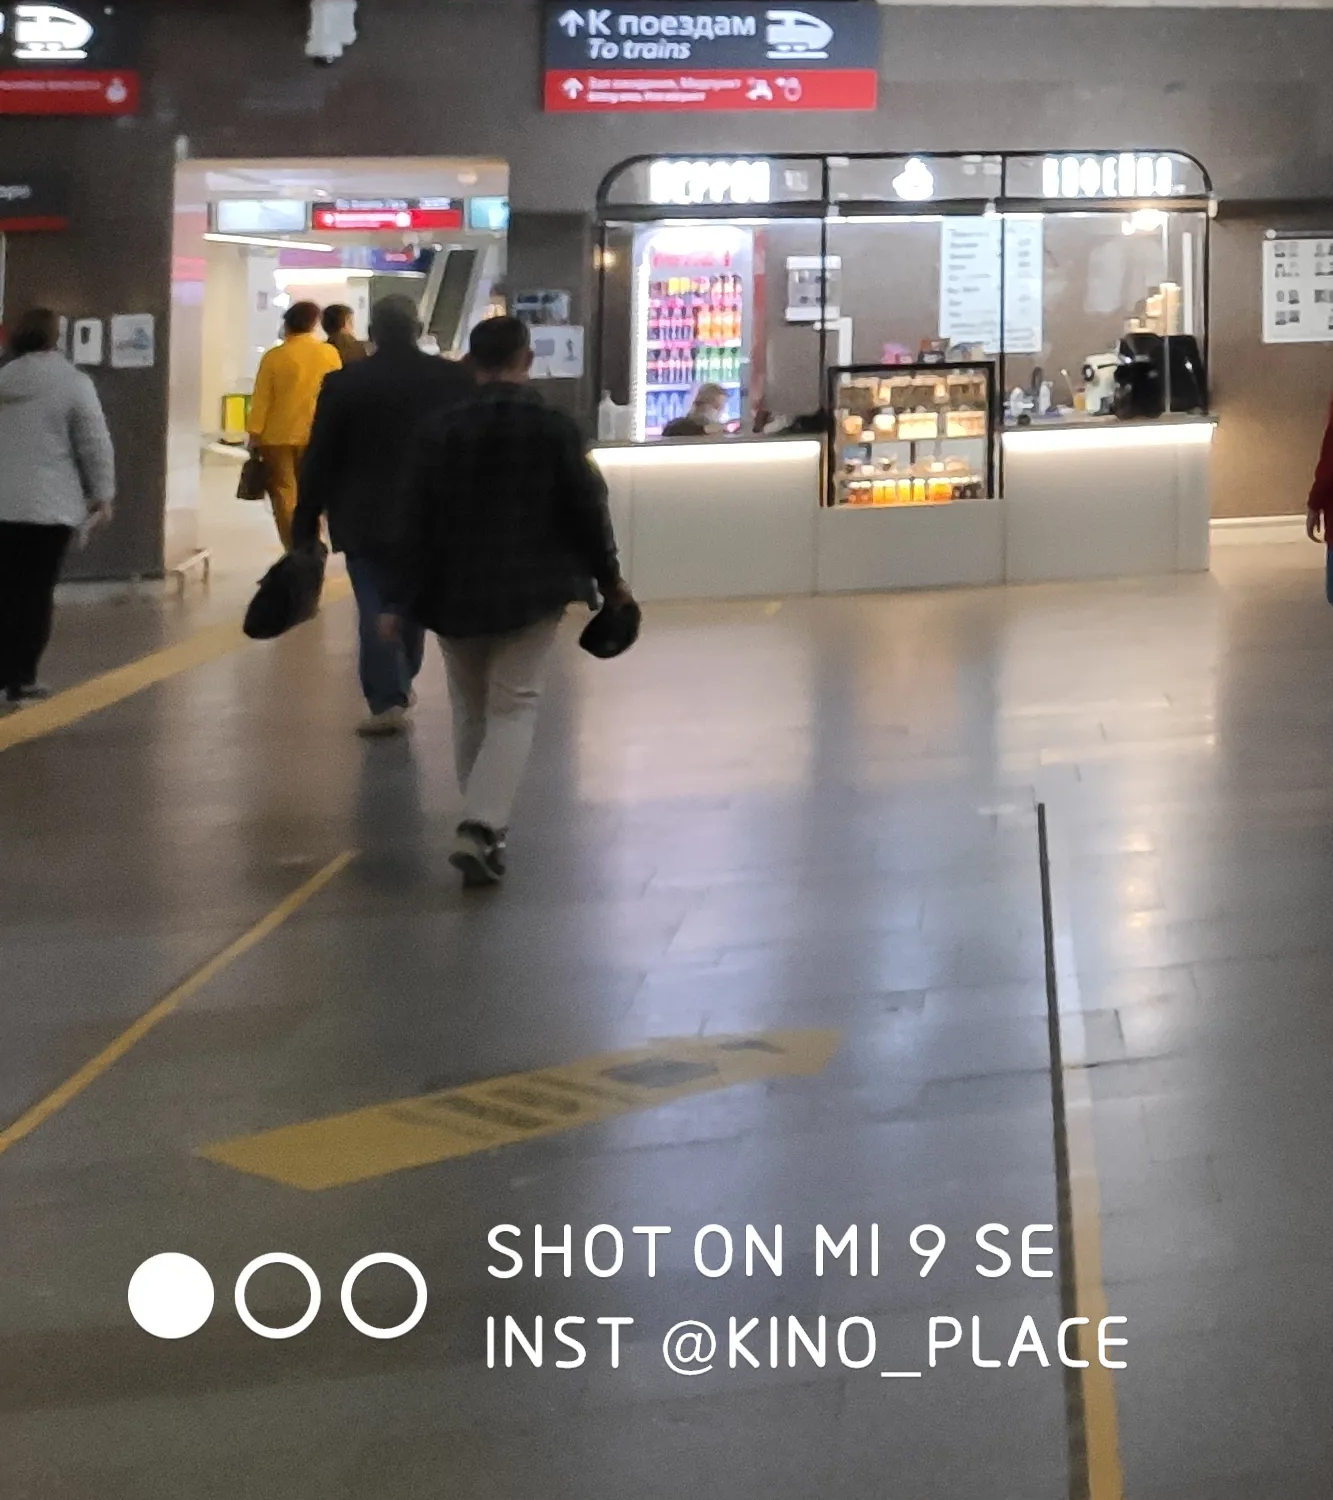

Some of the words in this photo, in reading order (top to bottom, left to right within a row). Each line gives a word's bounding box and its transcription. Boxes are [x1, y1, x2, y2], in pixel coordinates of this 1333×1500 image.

[588, 9, 611, 35] К
[619, 14, 756, 40] поездам
[589, 38, 619, 59] To
[623, 39, 691, 60] trains
